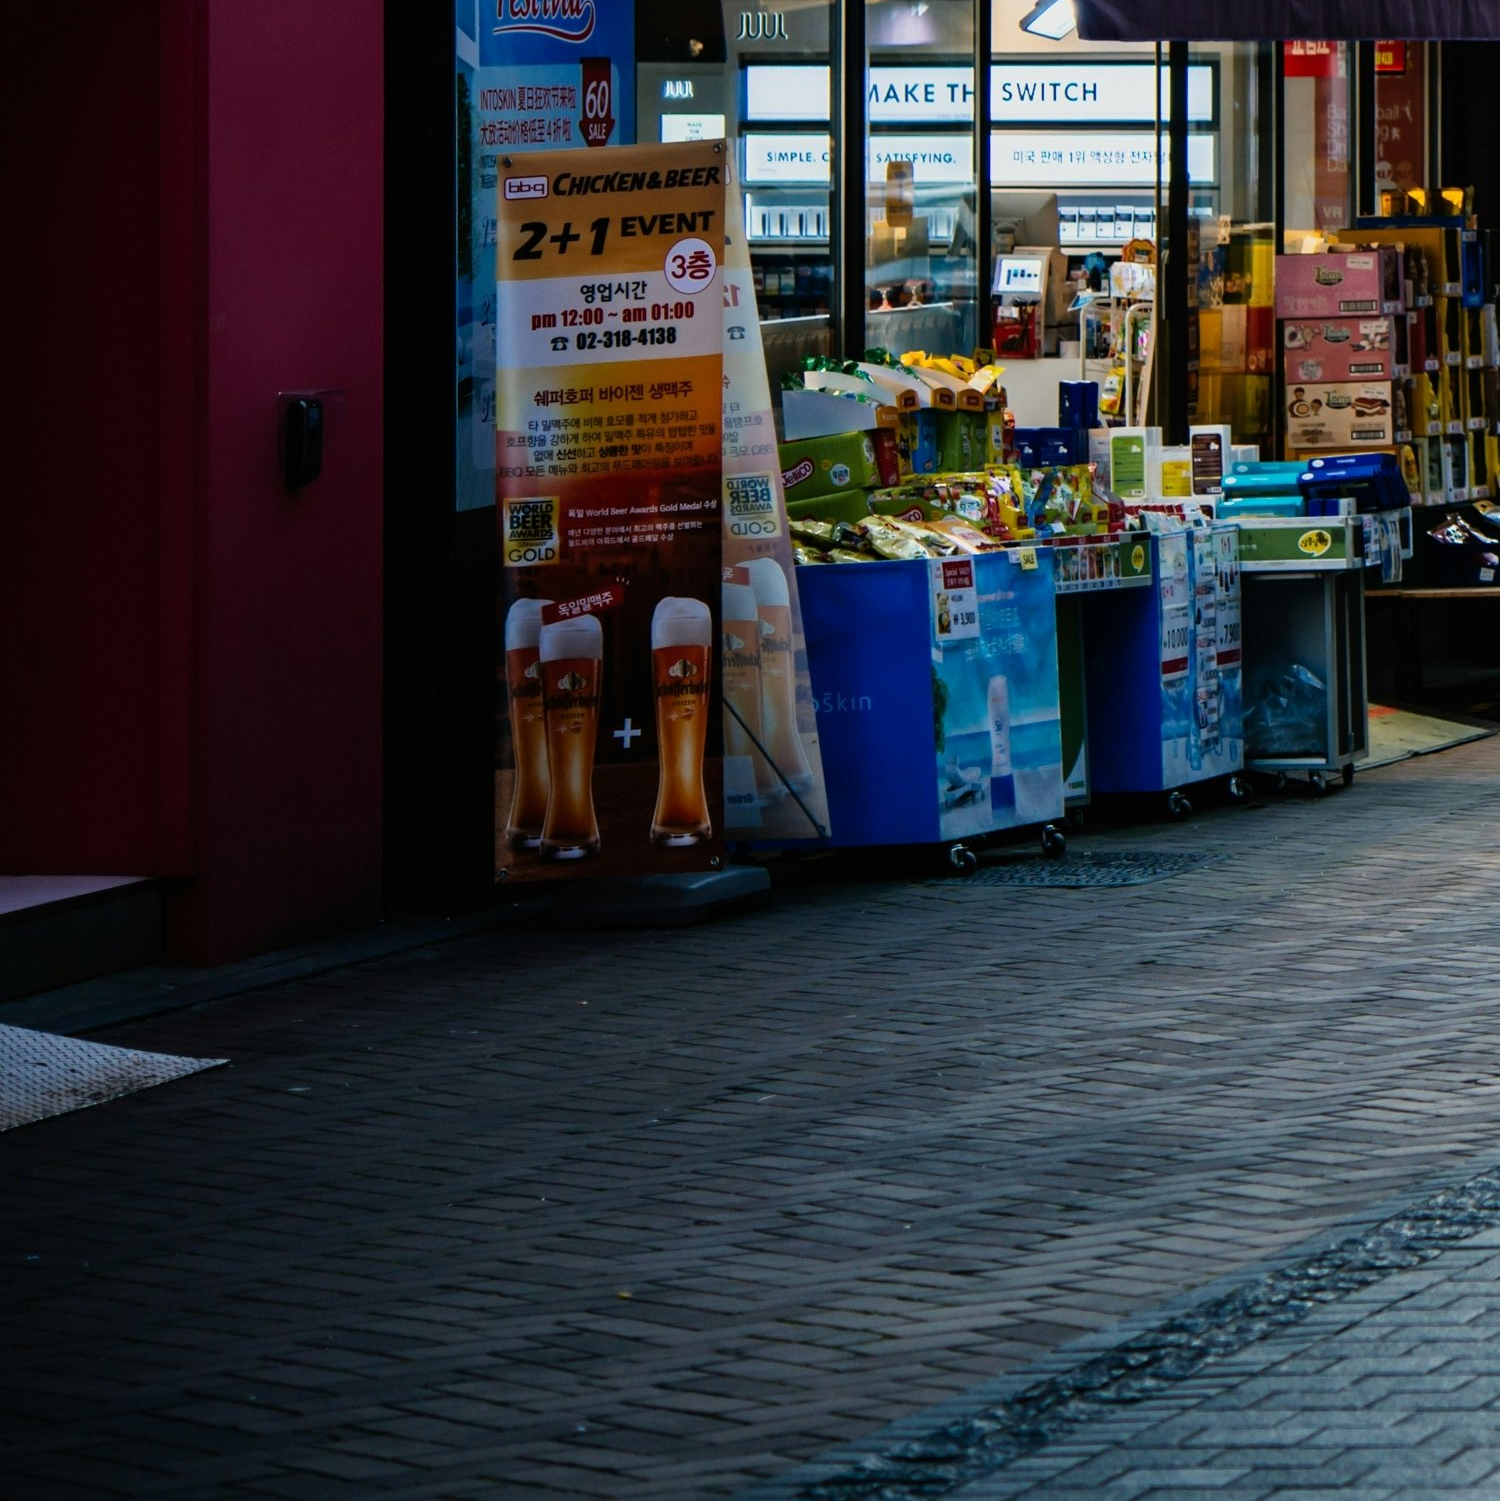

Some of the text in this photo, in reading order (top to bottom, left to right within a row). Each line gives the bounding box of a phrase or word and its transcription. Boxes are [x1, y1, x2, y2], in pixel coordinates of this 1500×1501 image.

[736, 12, 788, 40] JUUL
[584, 80, 609, 120] 60
[1001, 80, 1098, 103] SWITCH
[587, 123, 607, 141] SALE
[766, 151, 957, 165] SIMPLE. SATISFYING.
[1012, 149, 1064, 165] 미국 판매
[513, 210, 715, 261] 2+1 EVENT
[671, 251, 712, 280] 3층
[580, 281, 647, 304] 영업시간
[531, 301, 695, 331] pm 12:00 am 01:00
[576, 326, 677, 351] 02-318-4138
[599, 383, 644, 402] 바이젠
[648, 380, 694, 400] 생맥주
[509, 502, 553, 515] WORLD
[567, 500, 702, 519] 독일 World Beer Awards Gold Medal
[509, 515, 552, 530] BEER
[509, 529, 554, 539] AWARDS
[508, 547, 556, 563] GOLD
[557, 591, 614, 618] 독일밀맥주
